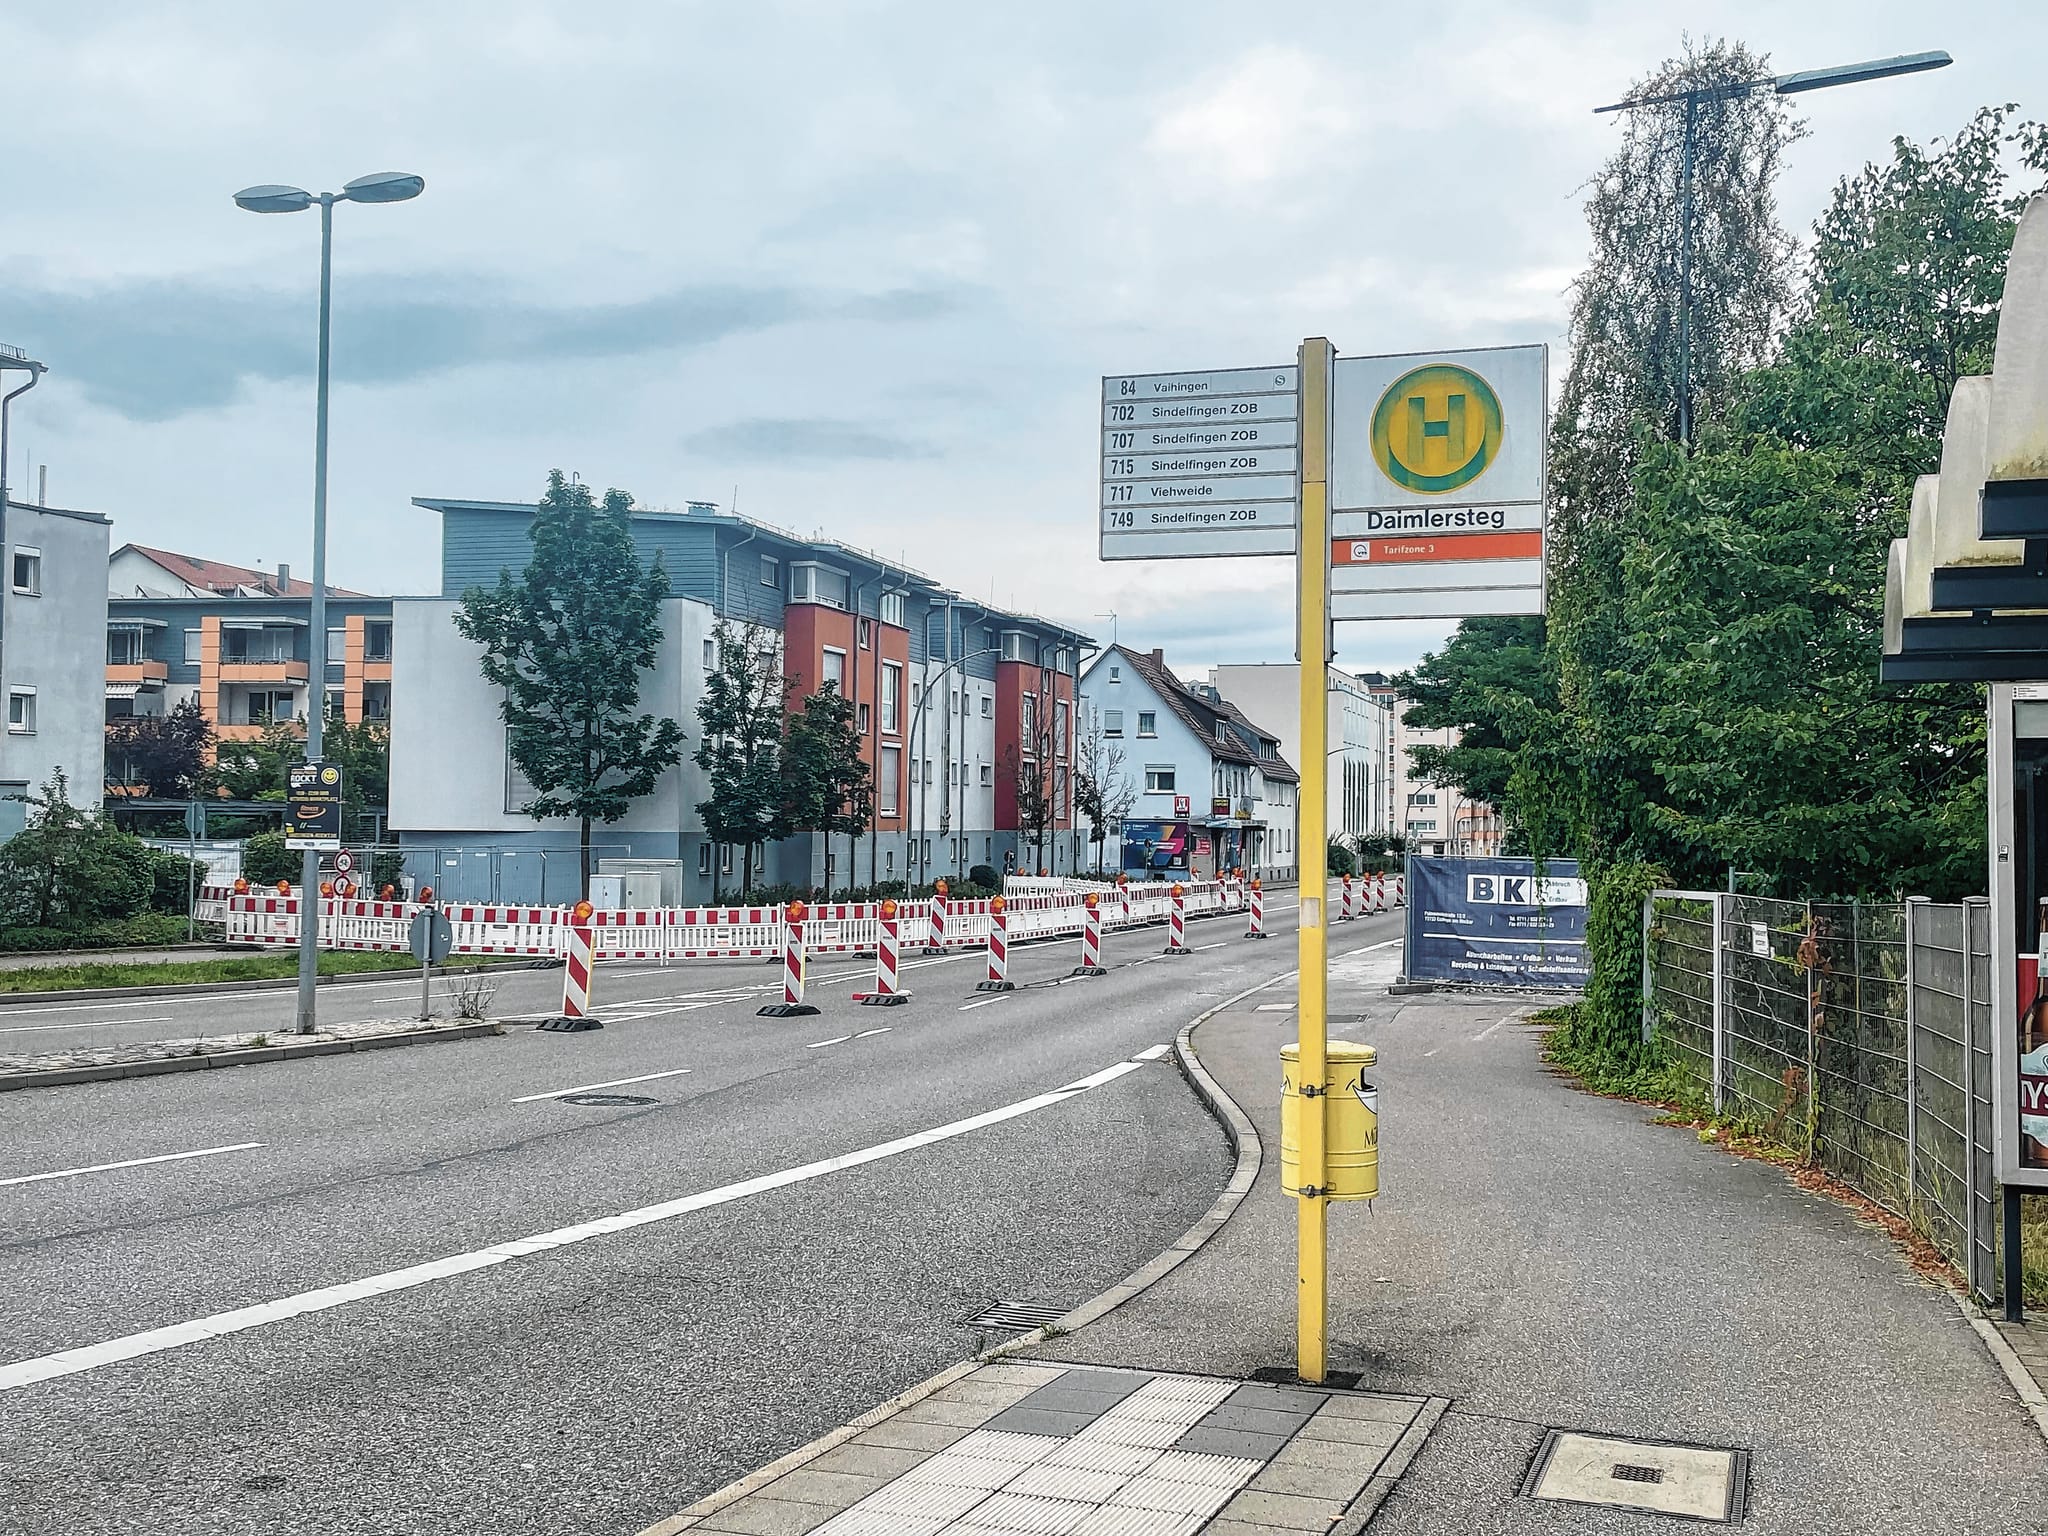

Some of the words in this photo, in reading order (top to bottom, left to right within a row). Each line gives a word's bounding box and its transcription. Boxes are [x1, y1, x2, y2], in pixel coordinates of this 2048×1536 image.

[1120, 380, 1136, 396] 84
[1153, 382, 1208, 393] Vaihingen
[1111, 405, 1135, 421] 702
[1151, 405, 1227, 418] Sindelfingen
[1230, 403, 1258, 415] ZOB
[1407, 393, 1466, 464] H
[1111, 432, 1135, 449] 707
[1152, 432, 1227, 445] Sindelfingen
[1230, 430, 1258, 442] ZOB
[1111, 459, 1134, 475] 715
[1151, 459, 1226, 472] Sindelfingen
[1229, 457, 1257, 469] ZOB
[1110, 485, 1134, 501] 717
[1150, 485, 1213, 497] Viehweide
[1110, 511, 1134, 527] 749
[1150, 511, 1226, 524] Sindelfingen
[1229, 510, 1257, 521] ZOB
[1367, 508, 1505, 529] Daimlersteg
[1383, 545, 1426, 555] Tarifzone
[1428, 544, 1435, 553] 3
[1522, 953, 1545, 962] Erdba
